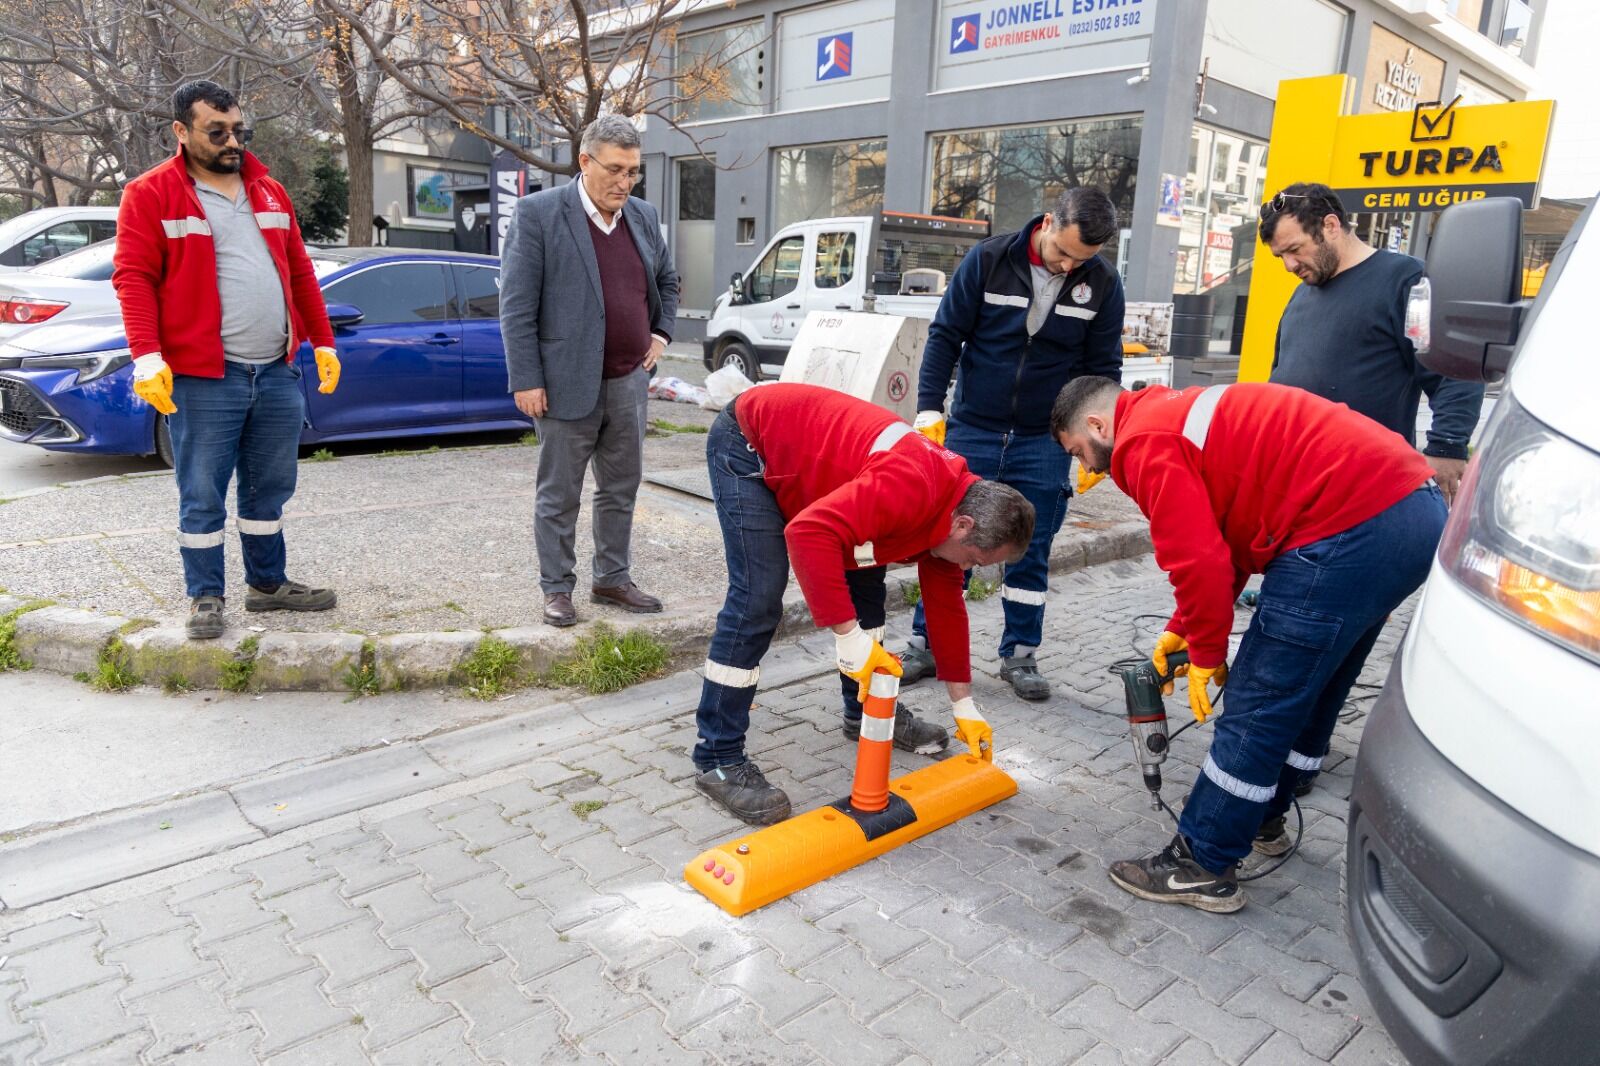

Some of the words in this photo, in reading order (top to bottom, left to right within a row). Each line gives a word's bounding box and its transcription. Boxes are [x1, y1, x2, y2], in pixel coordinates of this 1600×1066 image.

[986, 0, 1064, 30] JONNELL
[1069, 19, 1093, 36] (0232)
[1094, 16, 1112, 32] 502
[1114, 14, 1120, 28] 8
[1122, 11, 1141, 27] 502
[984, 25, 1061, 49] GAYRİMENKUL
[1386, 59, 1422, 96] YELKEN
[1359, 145, 1503, 177] TURPA
[1363, 192, 1411, 208] CEM
